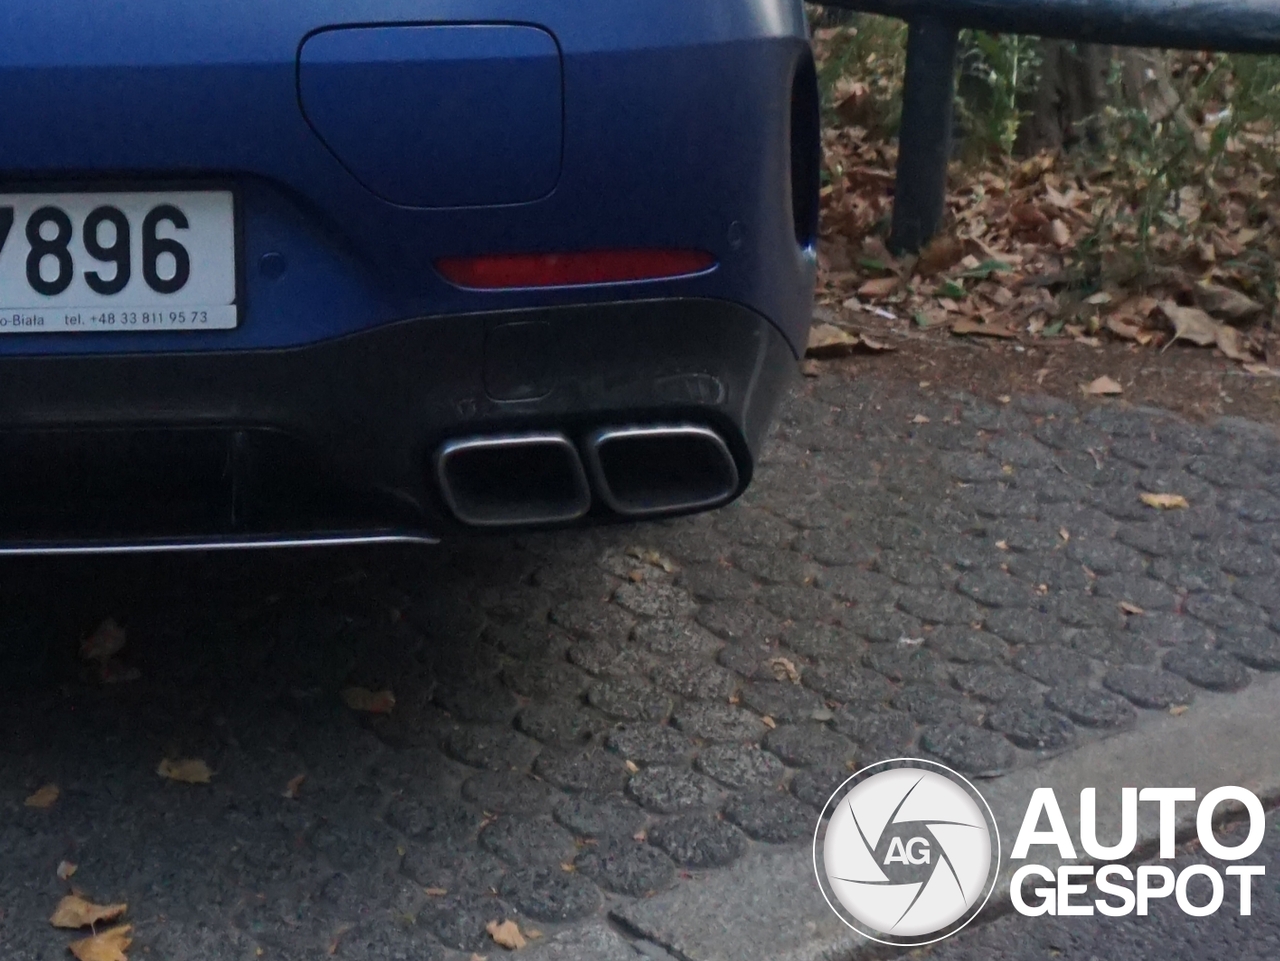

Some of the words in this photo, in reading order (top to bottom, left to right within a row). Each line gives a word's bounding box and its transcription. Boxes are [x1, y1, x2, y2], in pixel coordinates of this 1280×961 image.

[64, 313, 85, 326] tel.
[90, 312, 116, 325] +48
[120, 312, 138, 325] 33
[142, 312, 164, 325] 811
[169, 312, 186, 324] 95
[191, 311, 209, 324] 73
